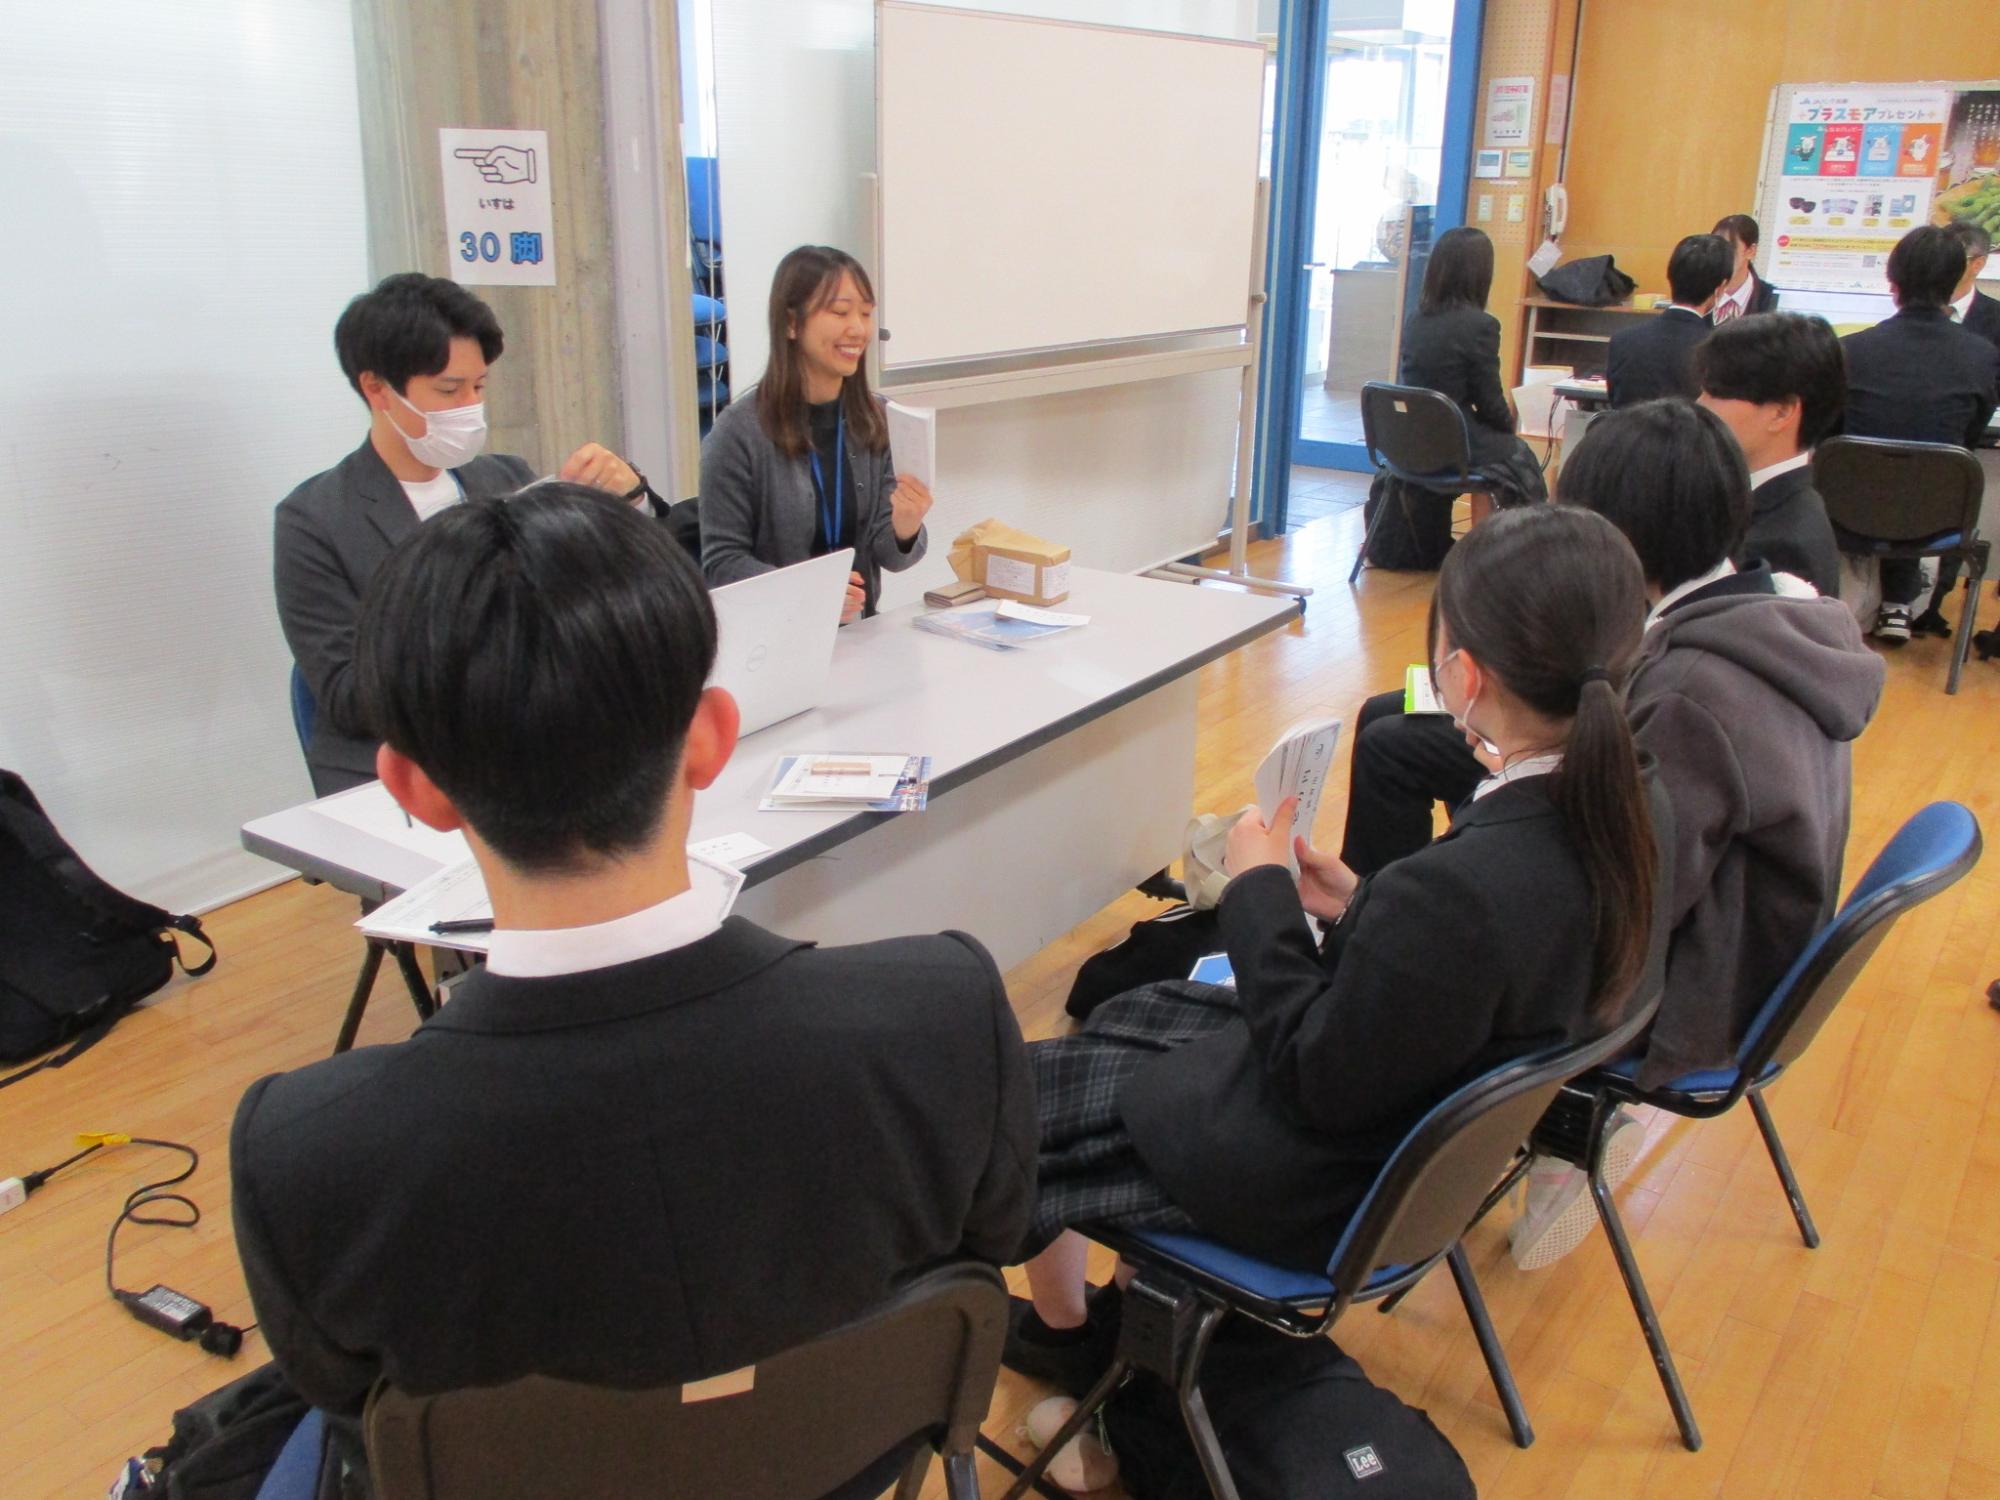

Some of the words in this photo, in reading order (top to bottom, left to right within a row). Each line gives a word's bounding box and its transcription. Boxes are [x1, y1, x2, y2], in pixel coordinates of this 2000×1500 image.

[479, 198, 515, 210] いすは
[1352, 1453, 1377, 1472] Lee
